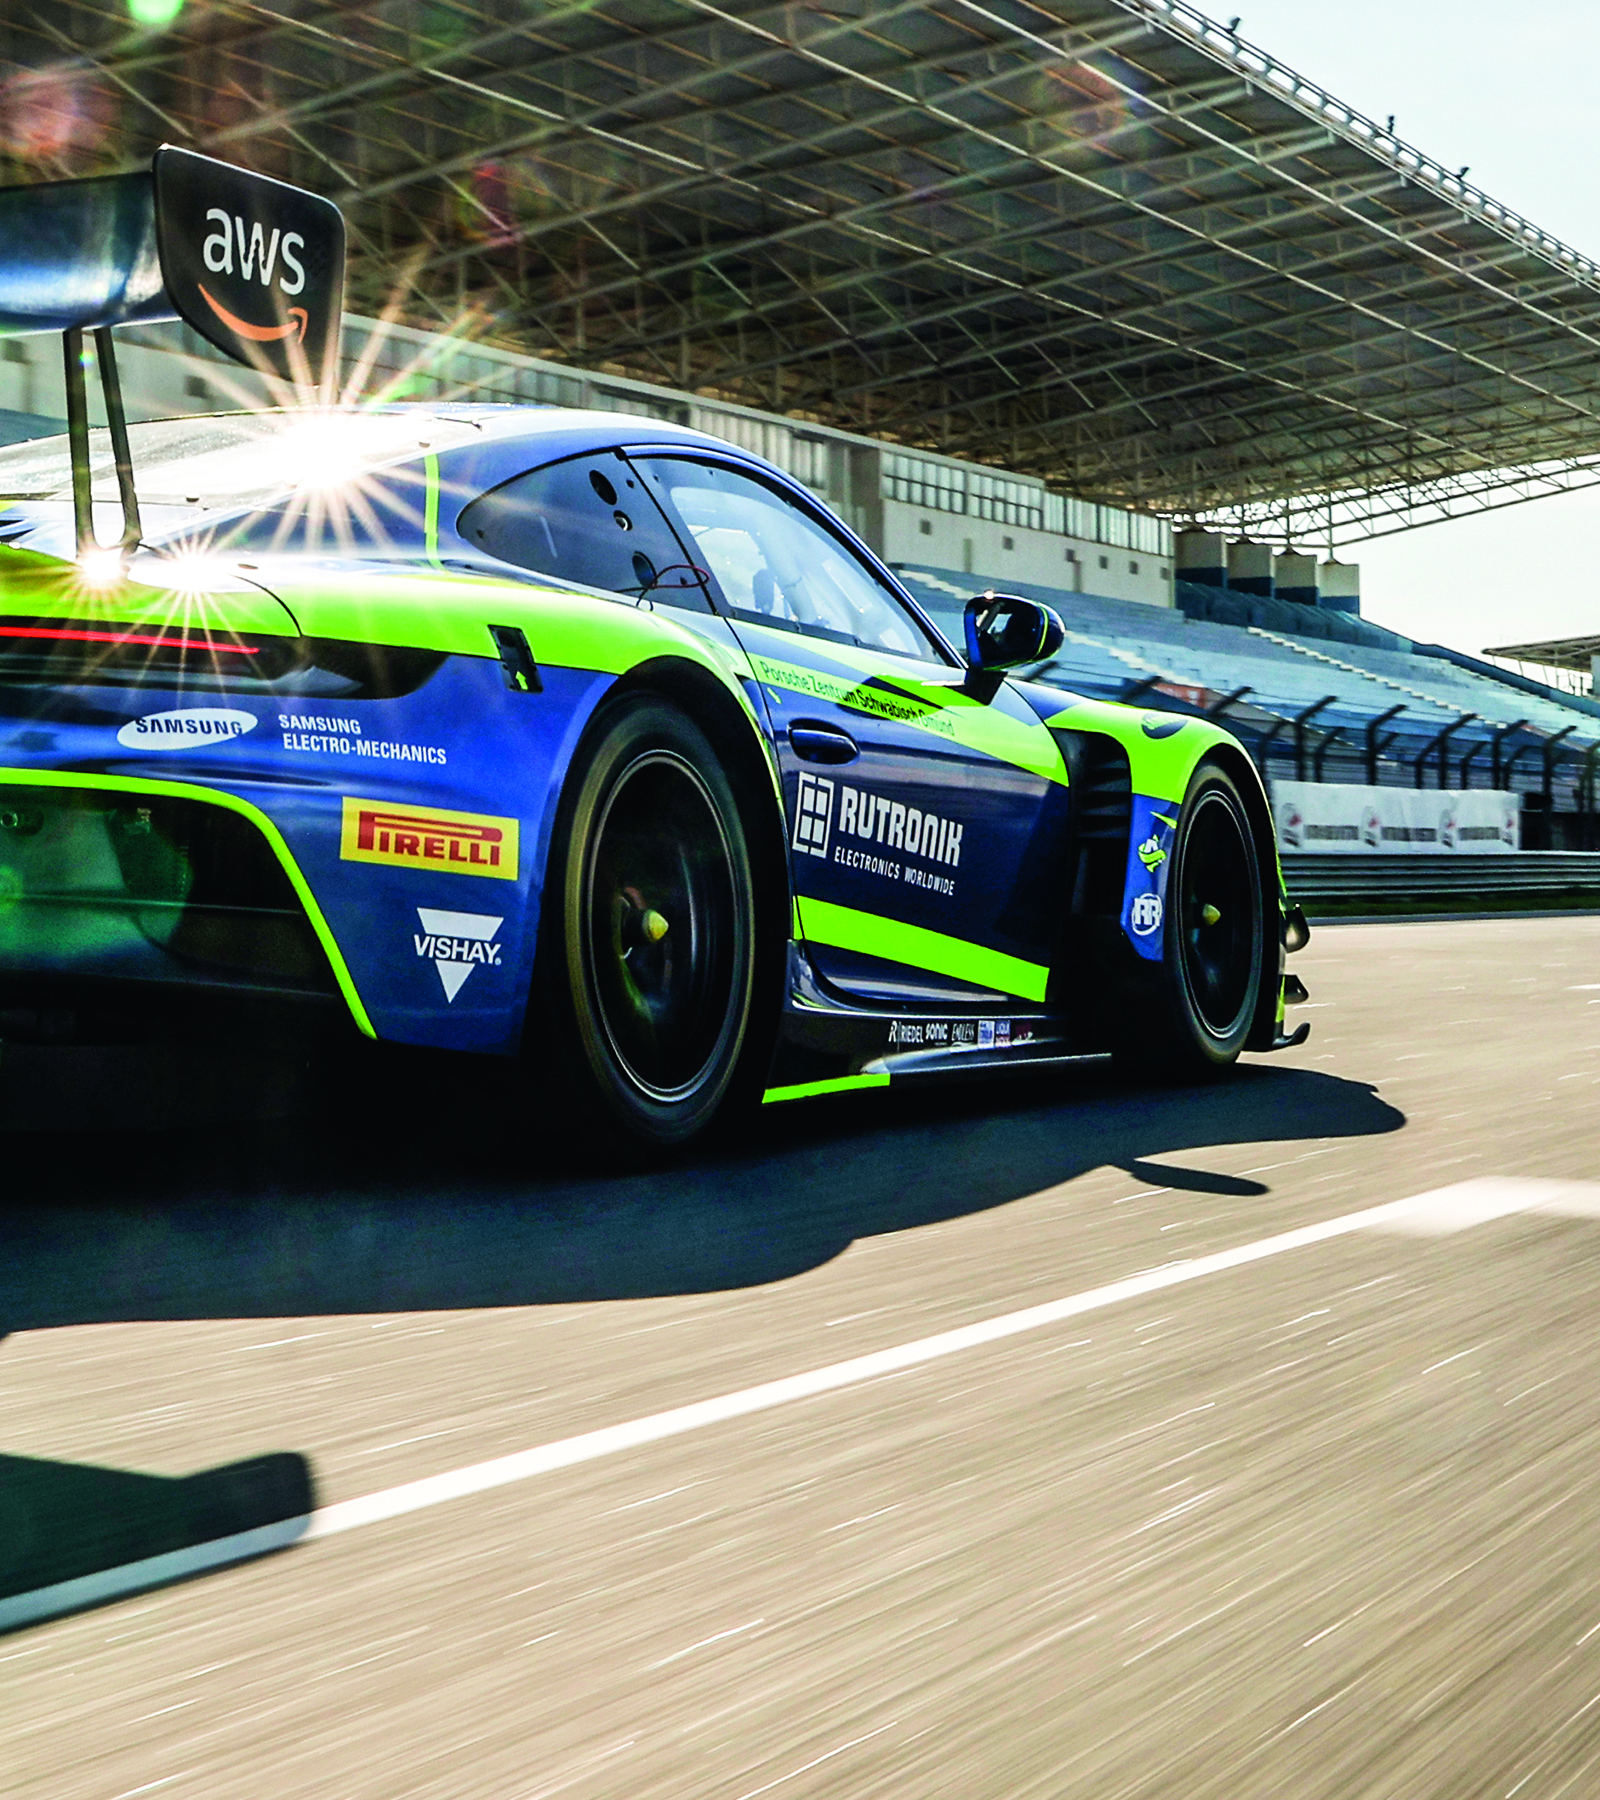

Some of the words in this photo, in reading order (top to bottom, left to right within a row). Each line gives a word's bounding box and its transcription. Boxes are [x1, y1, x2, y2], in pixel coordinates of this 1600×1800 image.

[203, 208, 305, 295] aws
[278, 713, 362, 735] SAMSUNG
[758, 660, 811, 692] Porsche
[808, 675, 859, 704] Zentrum
[856, 688, 919, 721] Schwäbisch
[916, 708, 956, 737] Gmünd
[134, 718, 244, 736] SAMSUNG
[282, 732, 448, 765] ELECTRO-MECHANICS
[357, 810, 504, 867] PIRELLI
[837, 785, 964, 868] RUTRONIK
[833, 845, 901, 880] ELECTRONICS
[903, 865, 956, 897] WORLDWIDE
[413, 933, 502, 966] VISHAY
